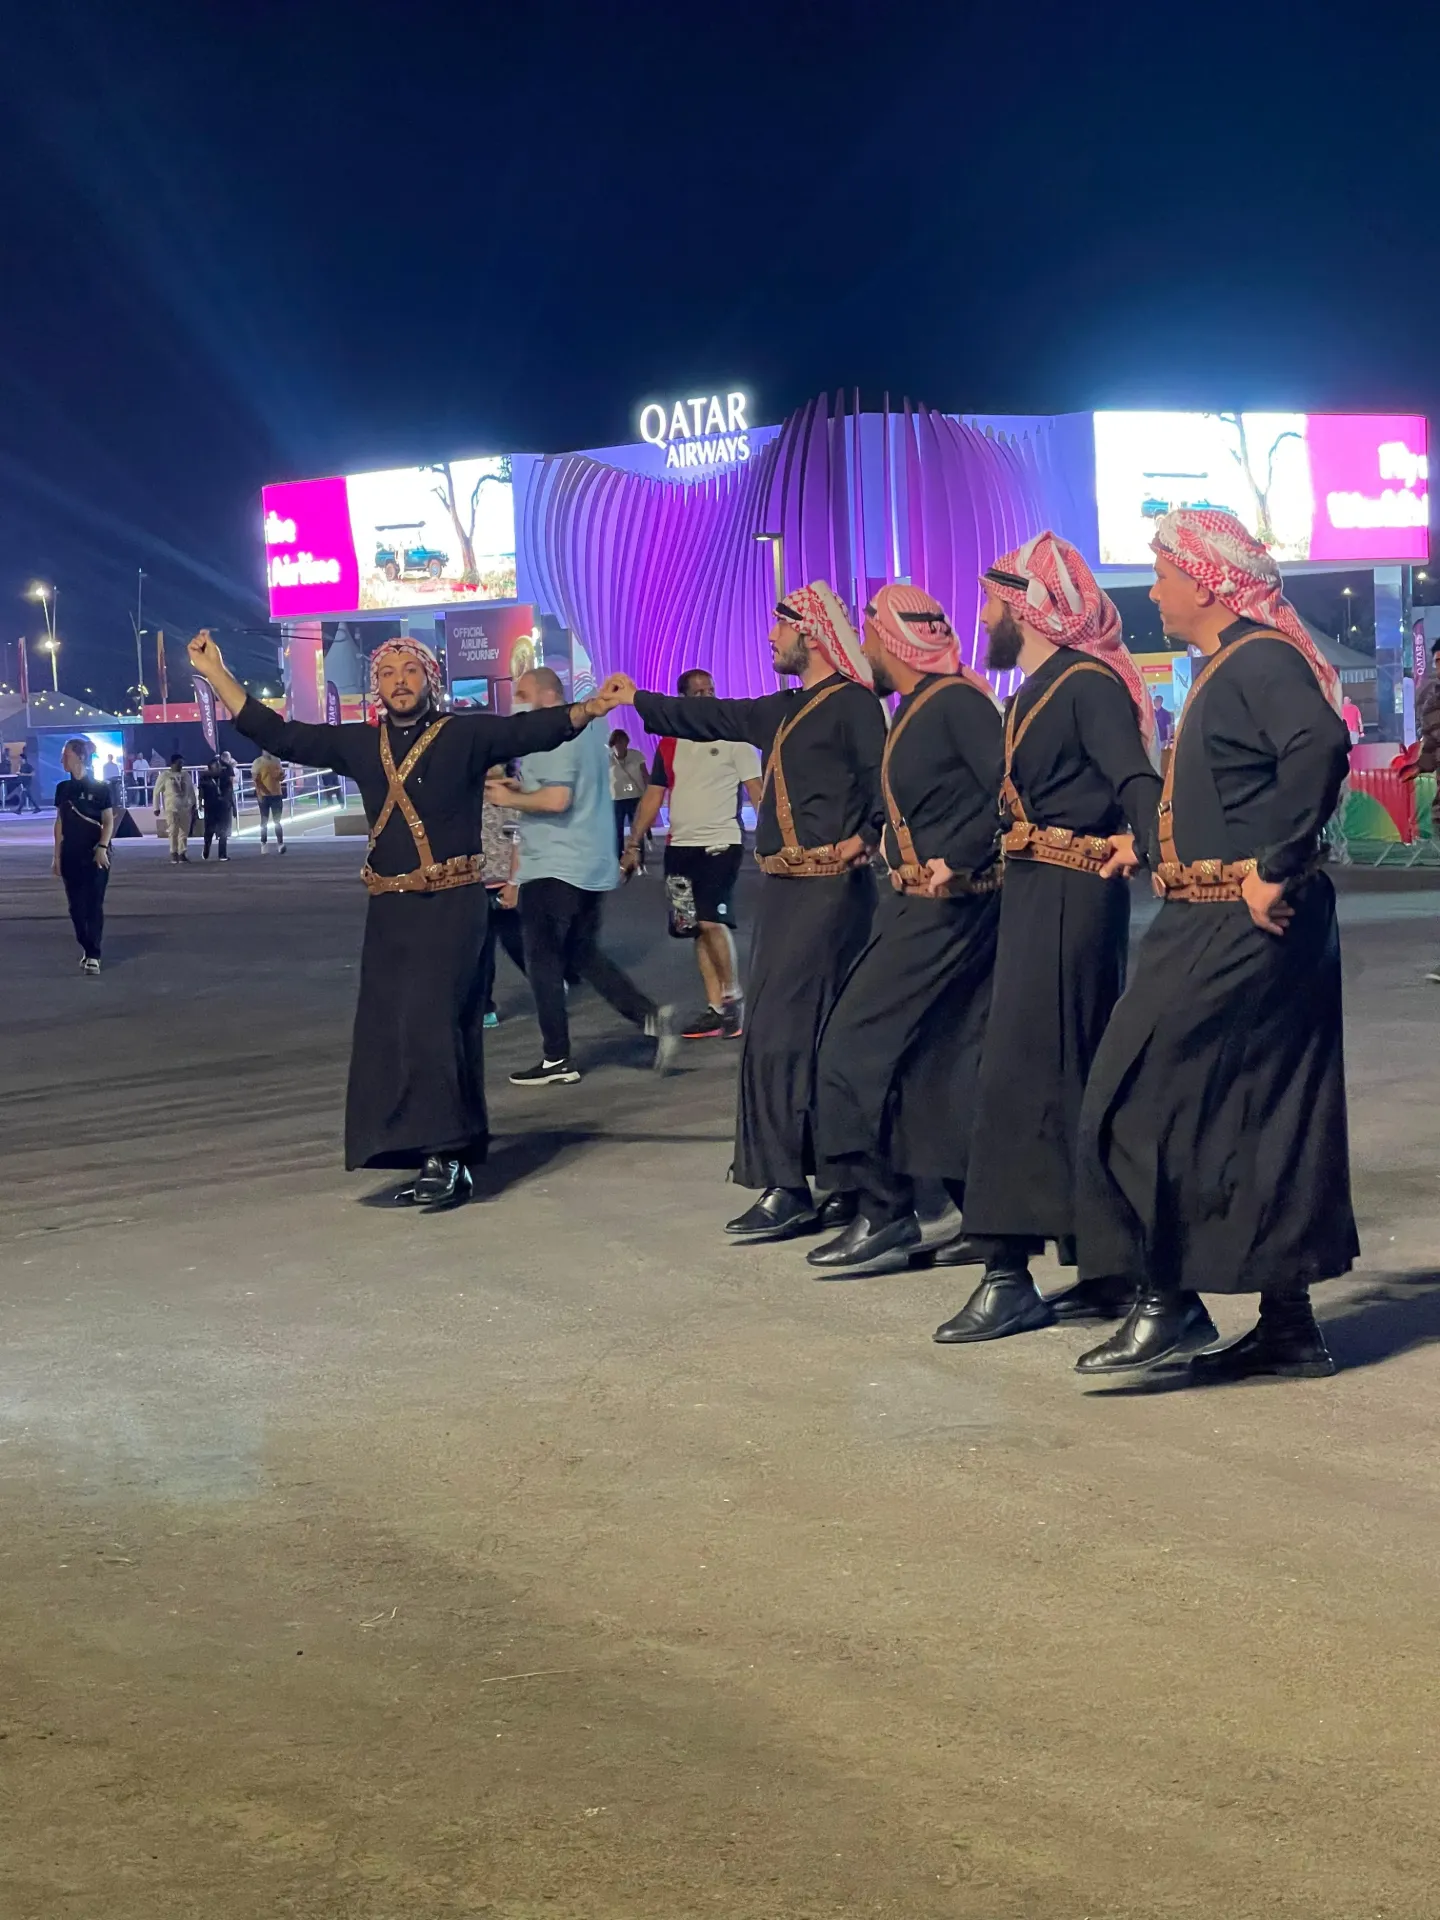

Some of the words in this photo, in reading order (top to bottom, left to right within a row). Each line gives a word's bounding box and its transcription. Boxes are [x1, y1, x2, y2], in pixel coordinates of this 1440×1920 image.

[640, 392, 748, 450] QATAR
[666, 435, 750, 469] AIRWAYS
[453, 626, 485, 637] OFFICIAL
[461, 638, 488, 649] AIRLINE
[467, 649, 499, 661] JOURNEY
[1415, 645, 1424, 675] QATAR
[204, 704, 214, 737] QATAR
